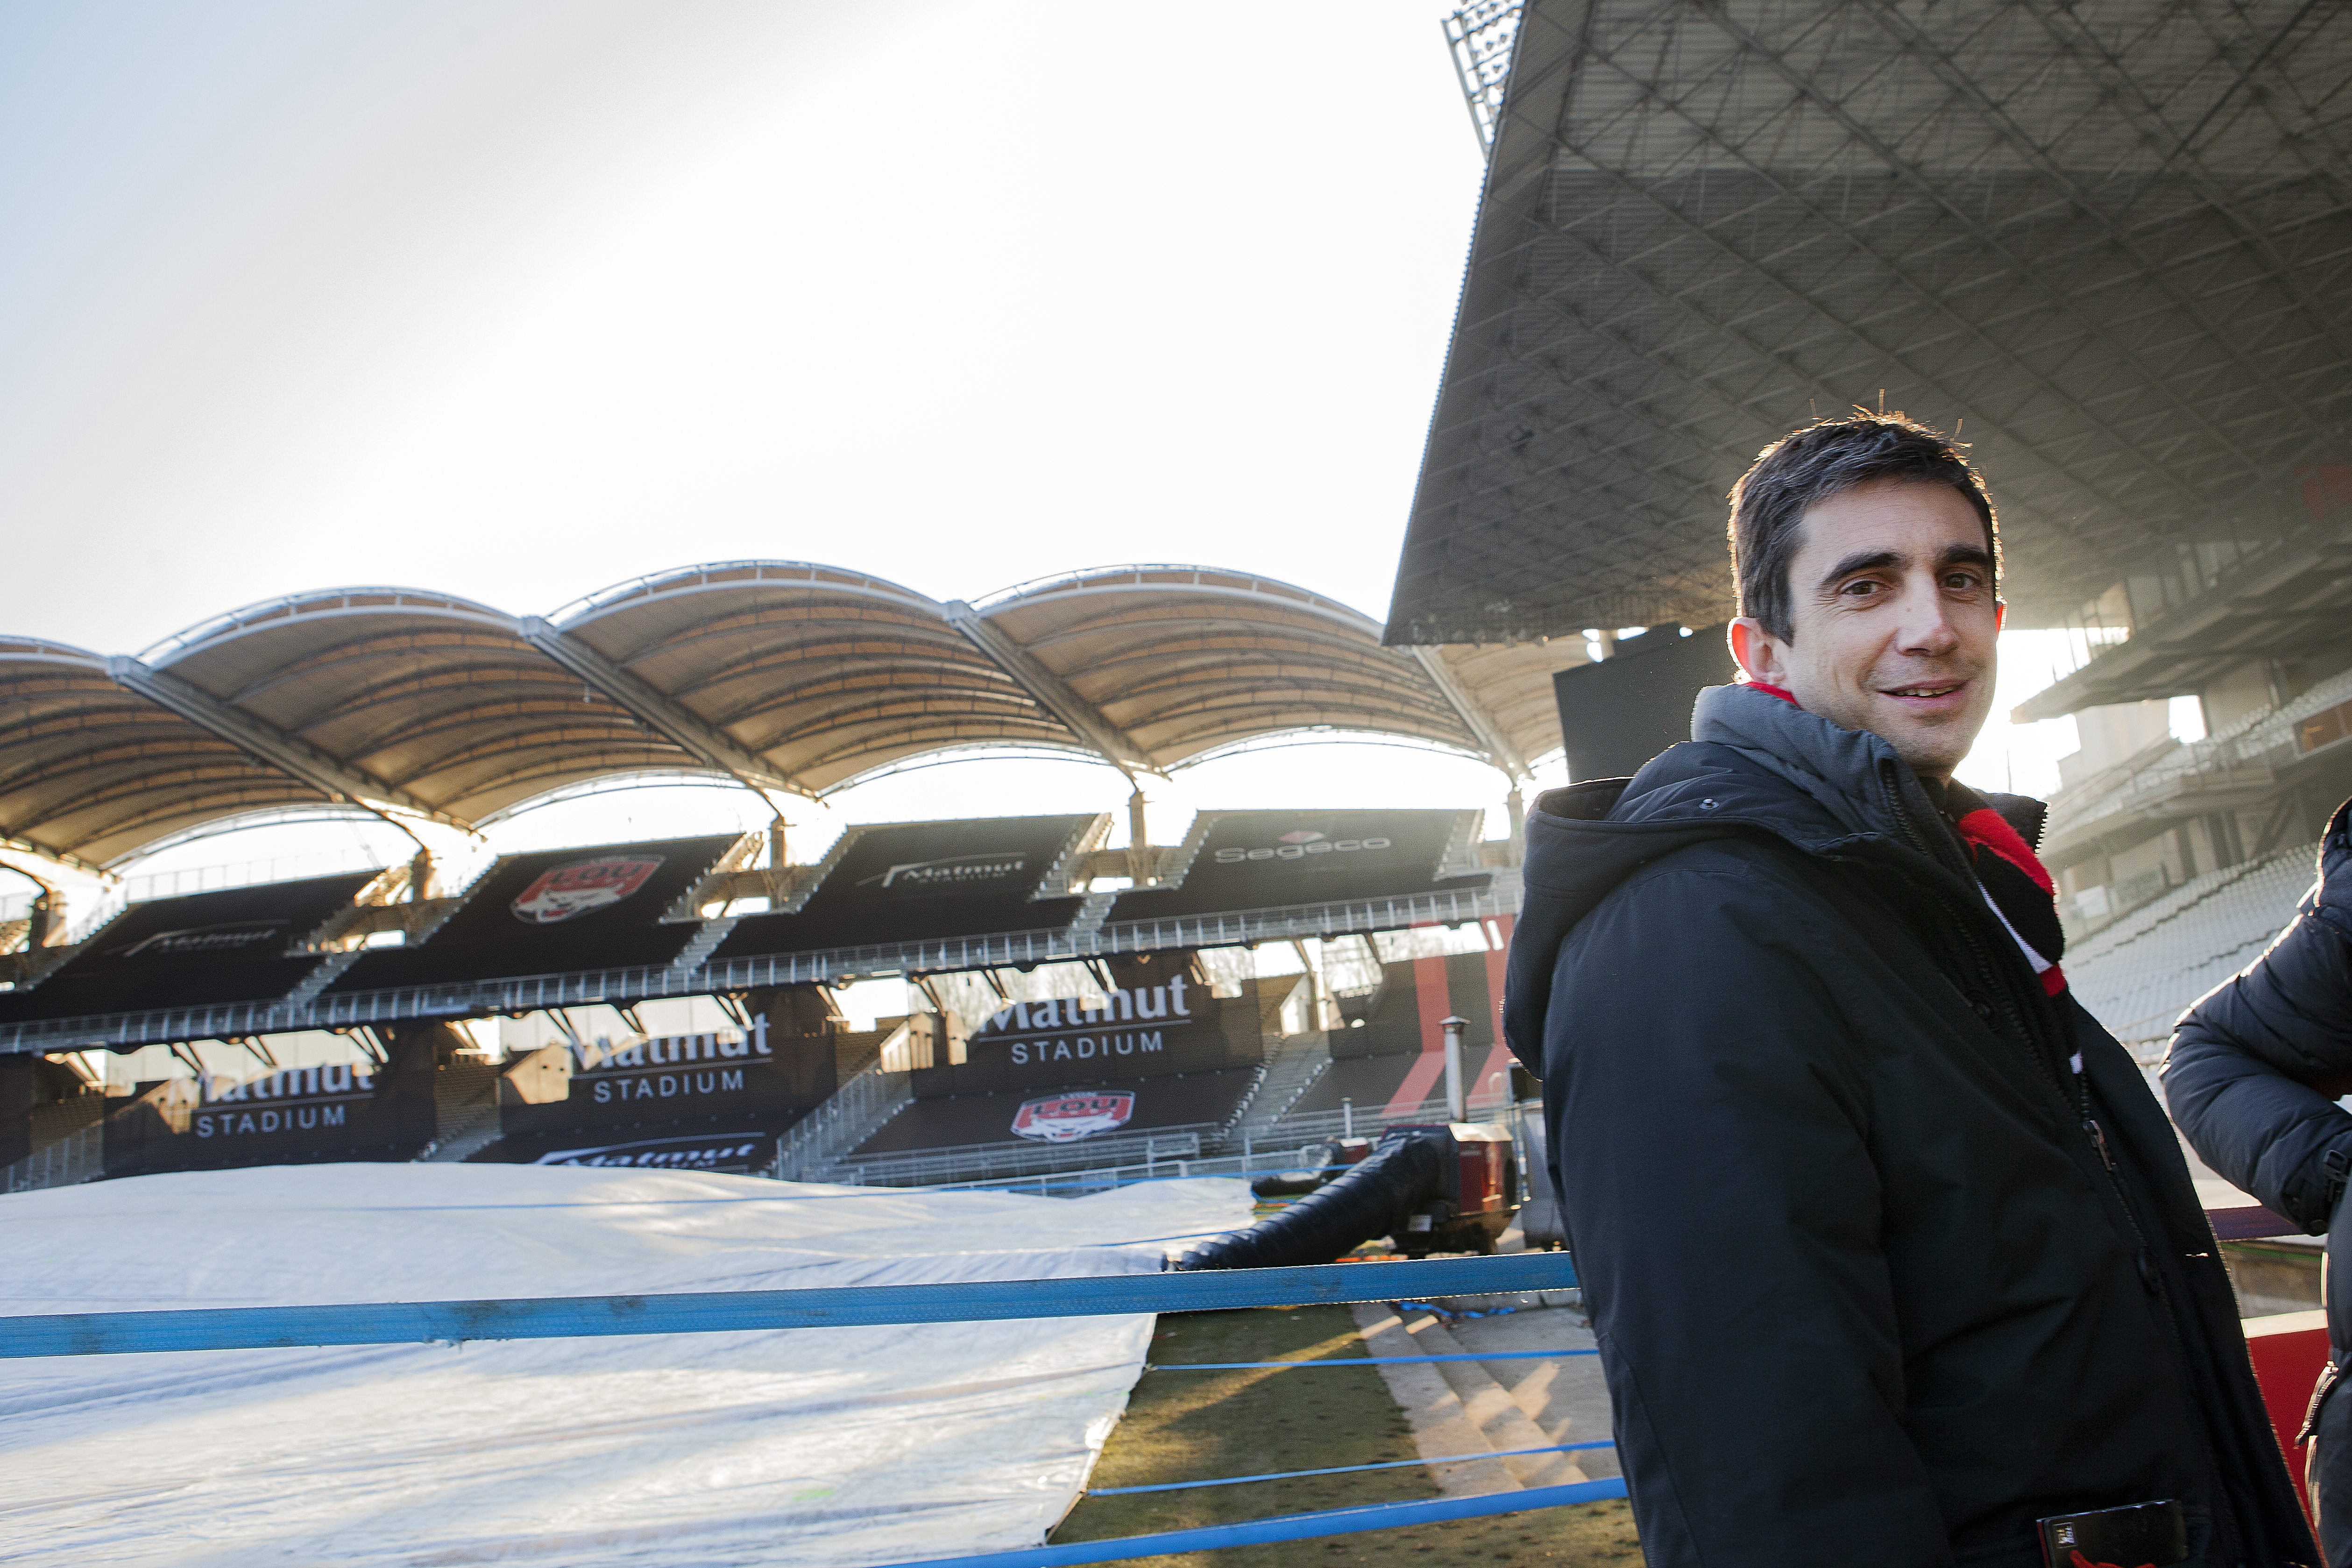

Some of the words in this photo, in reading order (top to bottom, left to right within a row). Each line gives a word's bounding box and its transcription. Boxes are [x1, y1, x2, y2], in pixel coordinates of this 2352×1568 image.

[1214, 837, 1391, 864] Segeco
[550, 864, 645, 885] LOU
[979, 974, 1190, 1034] Matmut
[1011, 1030, 1163, 1065] STADIUM
[595, 1069, 744, 1104] STADIUM
[197, 1104, 346, 1138] STADIUM
[1033, 1098, 1119, 1115] LOU
